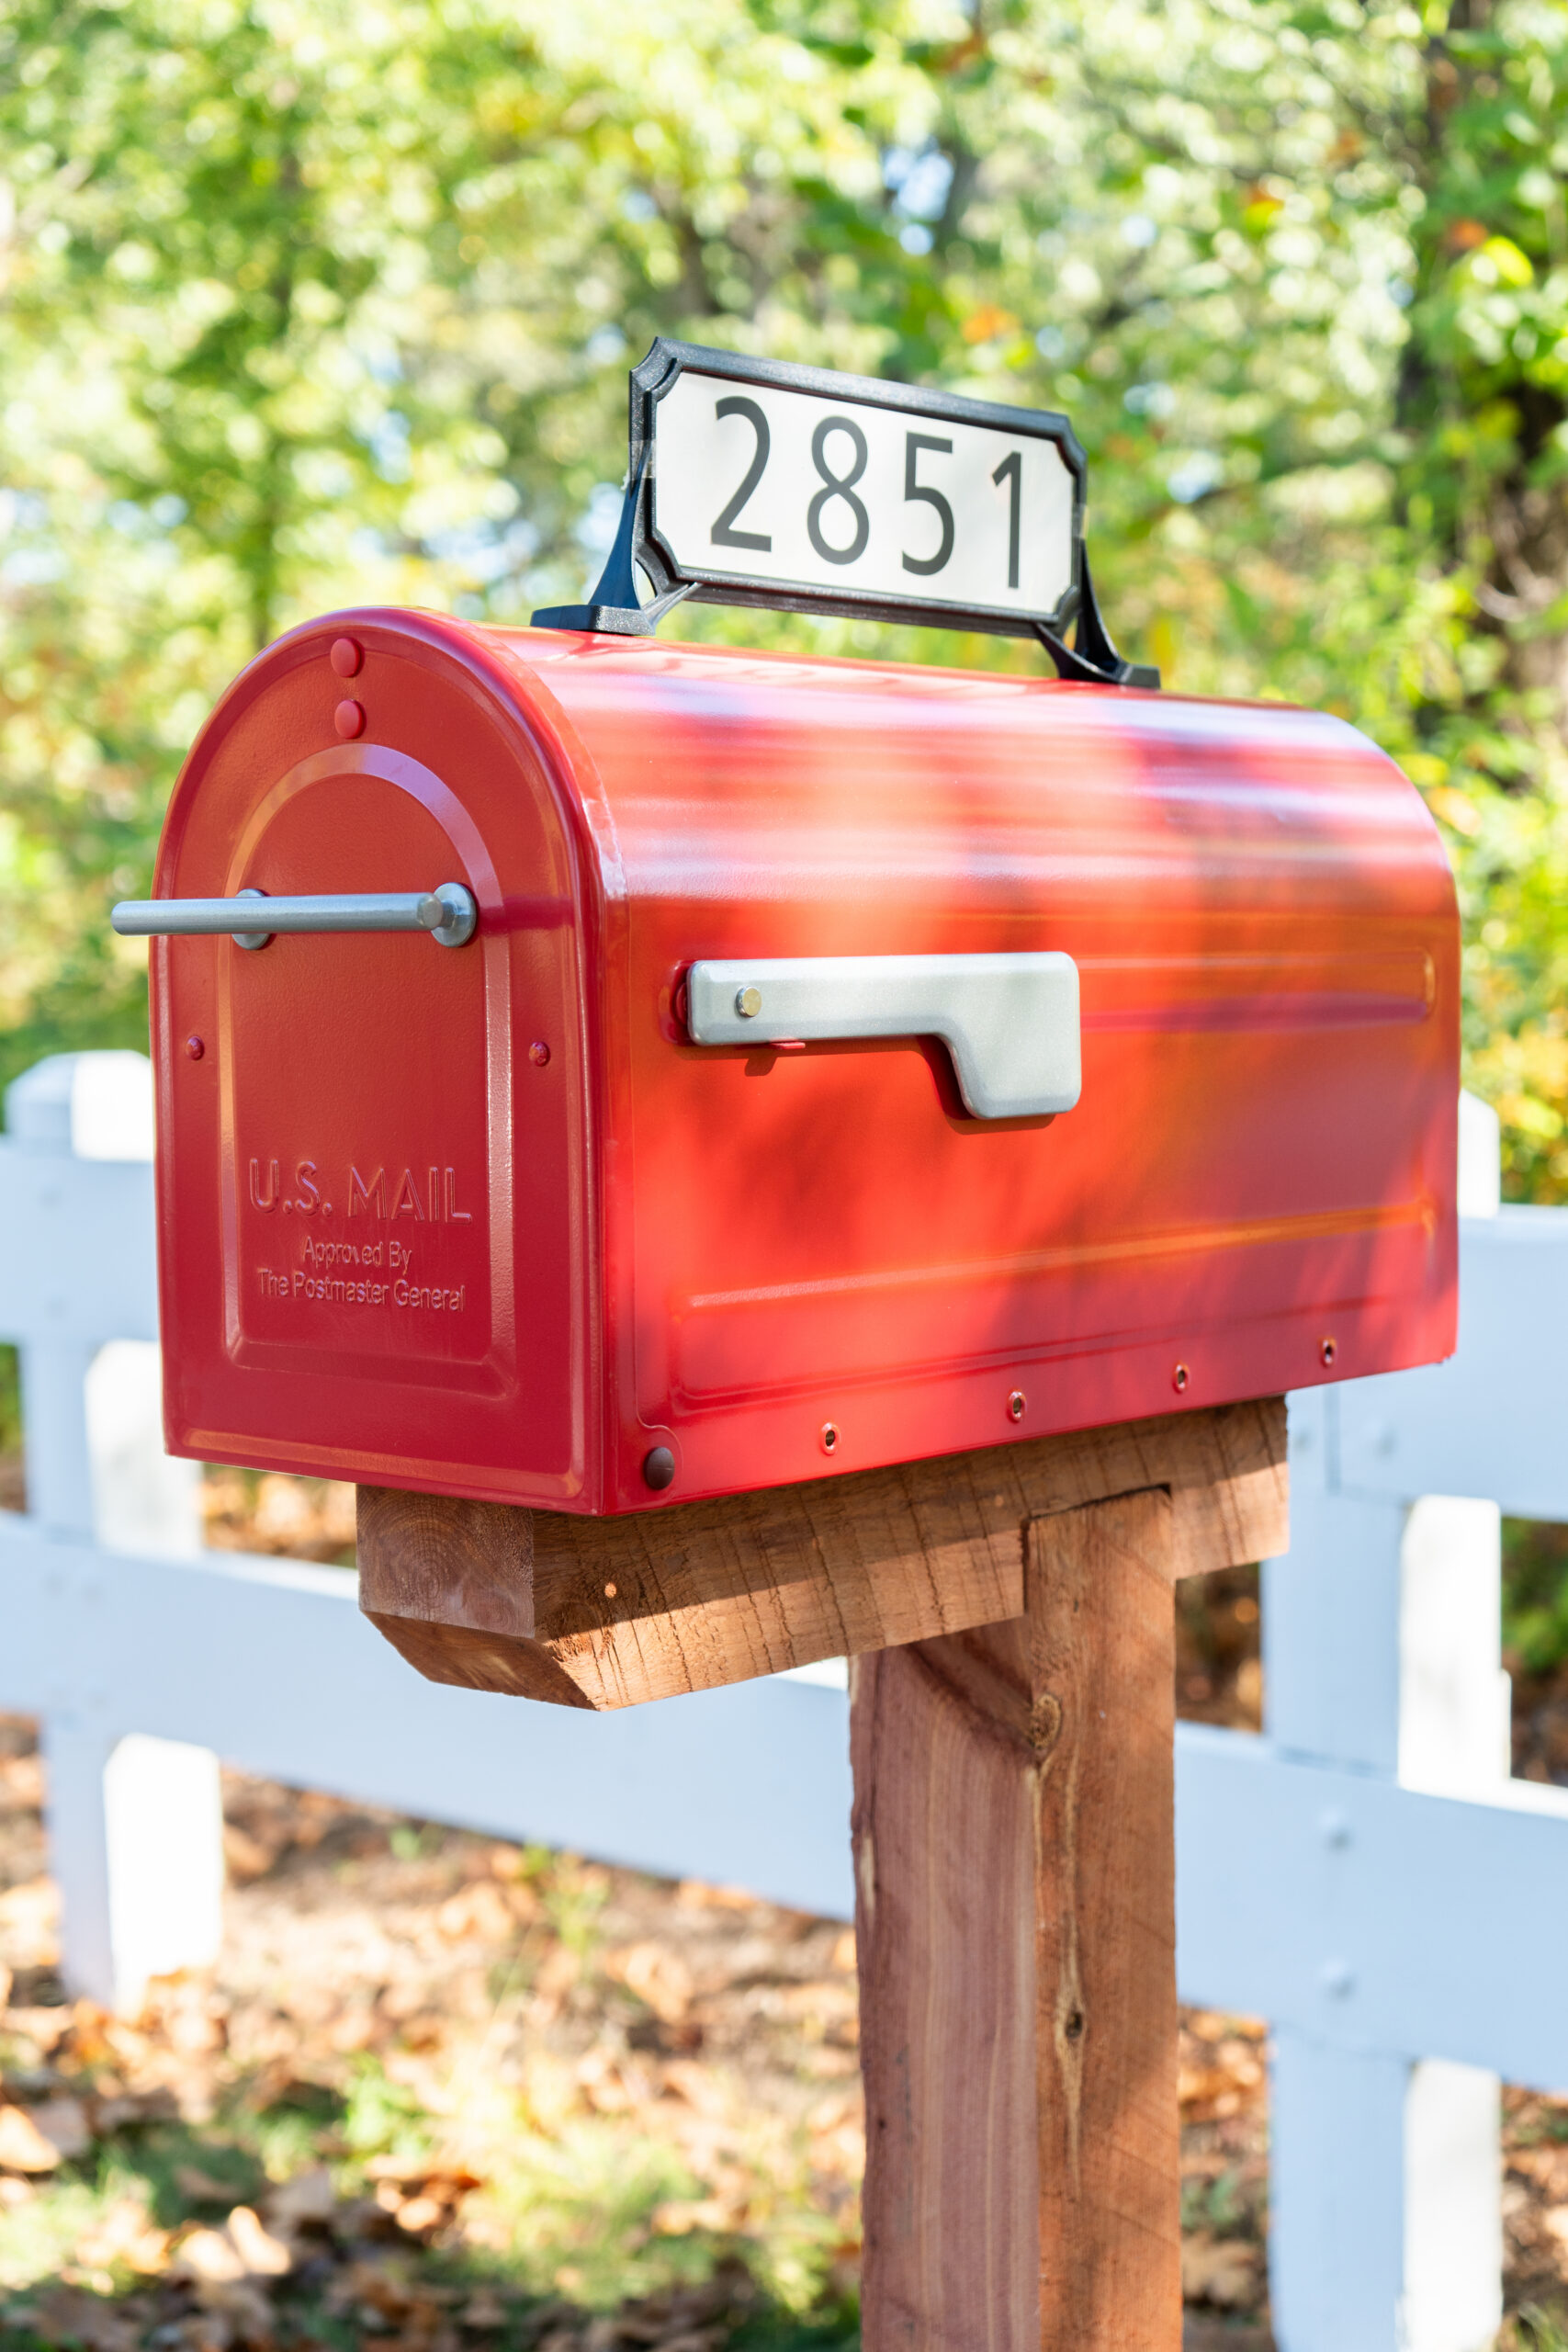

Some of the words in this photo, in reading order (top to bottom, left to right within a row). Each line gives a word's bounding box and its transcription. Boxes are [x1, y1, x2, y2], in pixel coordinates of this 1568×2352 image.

[710, 395, 1022, 589] 2851
[249, 1158, 333, 1216] U.S.
[348, 1164, 473, 1225] MAIL
[302, 1236, 383, 1269] Approved
[389, 1241, 412, 1275] By
[257, 1267, 289, 1297] The
[293, 1271, 389, 1305] Postmaster
[393, 1279, 465, 1311] General
